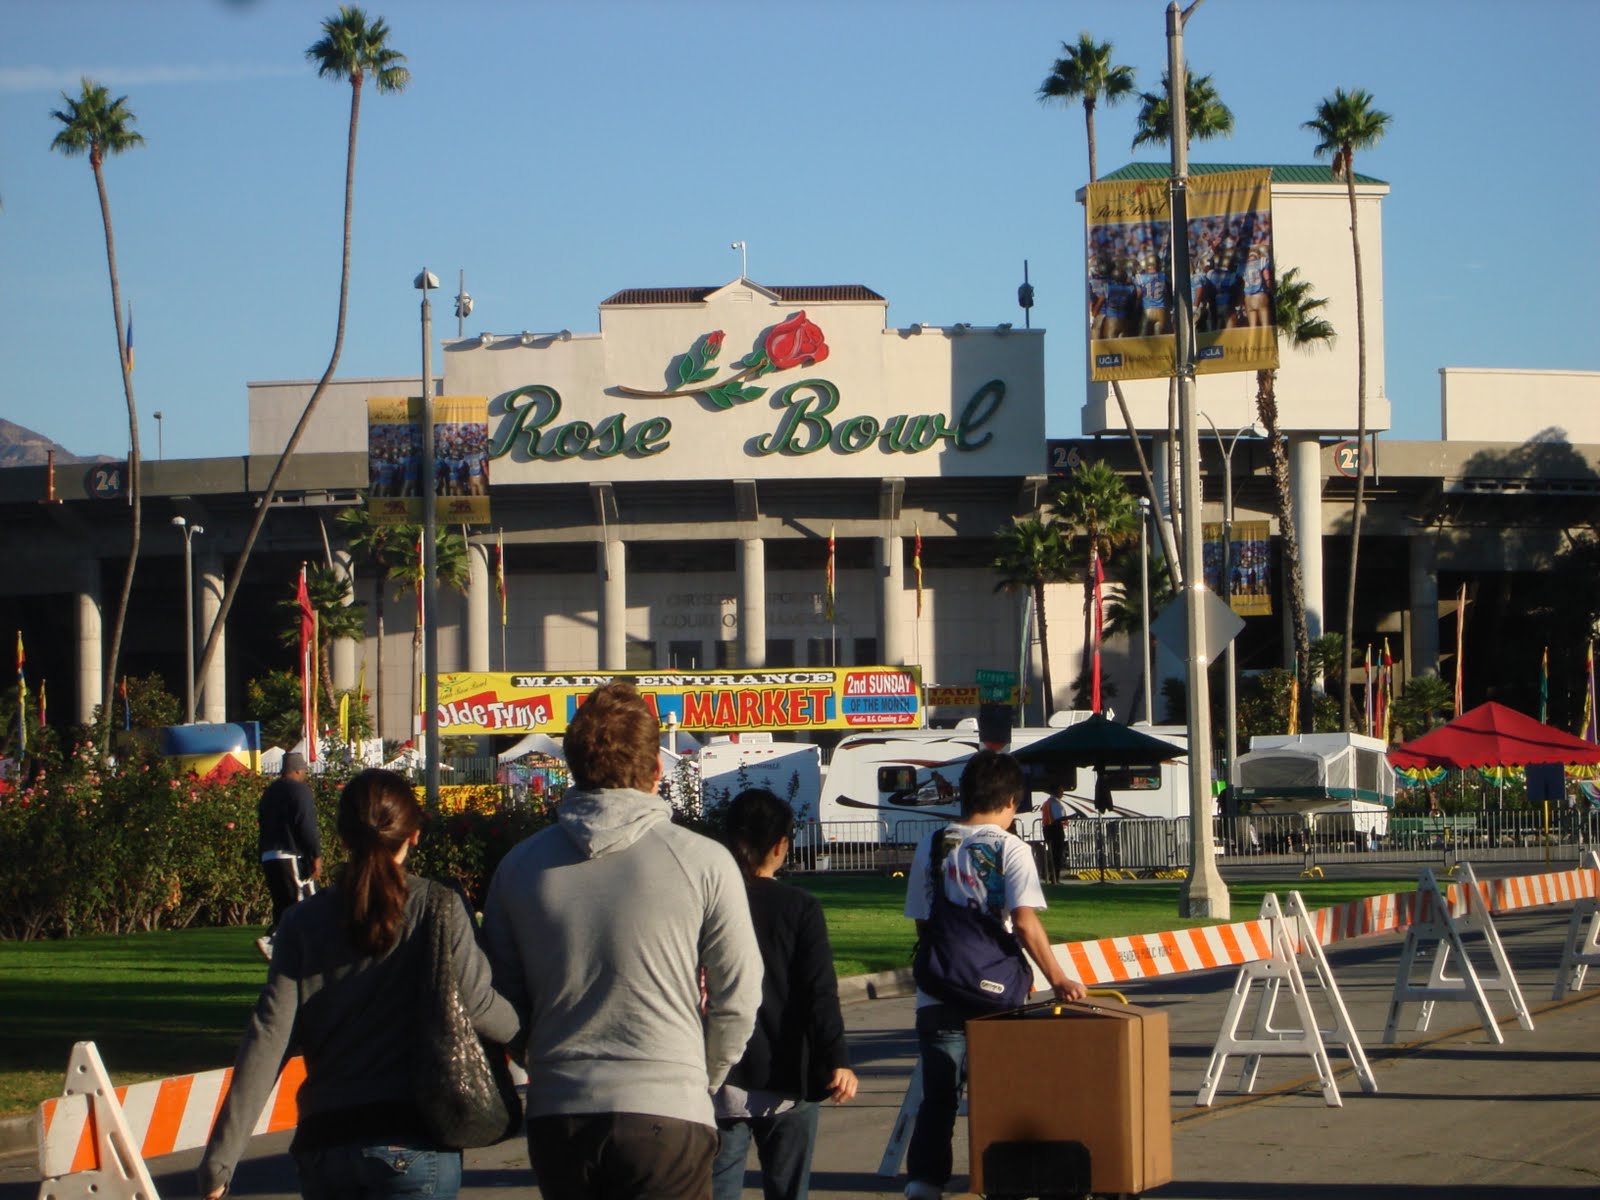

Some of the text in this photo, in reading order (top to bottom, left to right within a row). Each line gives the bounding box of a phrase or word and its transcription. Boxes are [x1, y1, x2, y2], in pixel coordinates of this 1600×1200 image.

[1098, 356, 1120, 365] UCLA
[488, 378, 1006, 460] Rose Bowl
[1053, 447, 1080, 468] 26
[95, 469, 120, 491] 24
[516, 671, 834, 688] MAIN ENTRANCE
[847, 674, 912, 694] 2nd SUNDAY
[680, 686, 834, 729] MARKET
[850, 697, 910, 712] OF THE MONTH
[487, 702, 548, 731] Tyme
